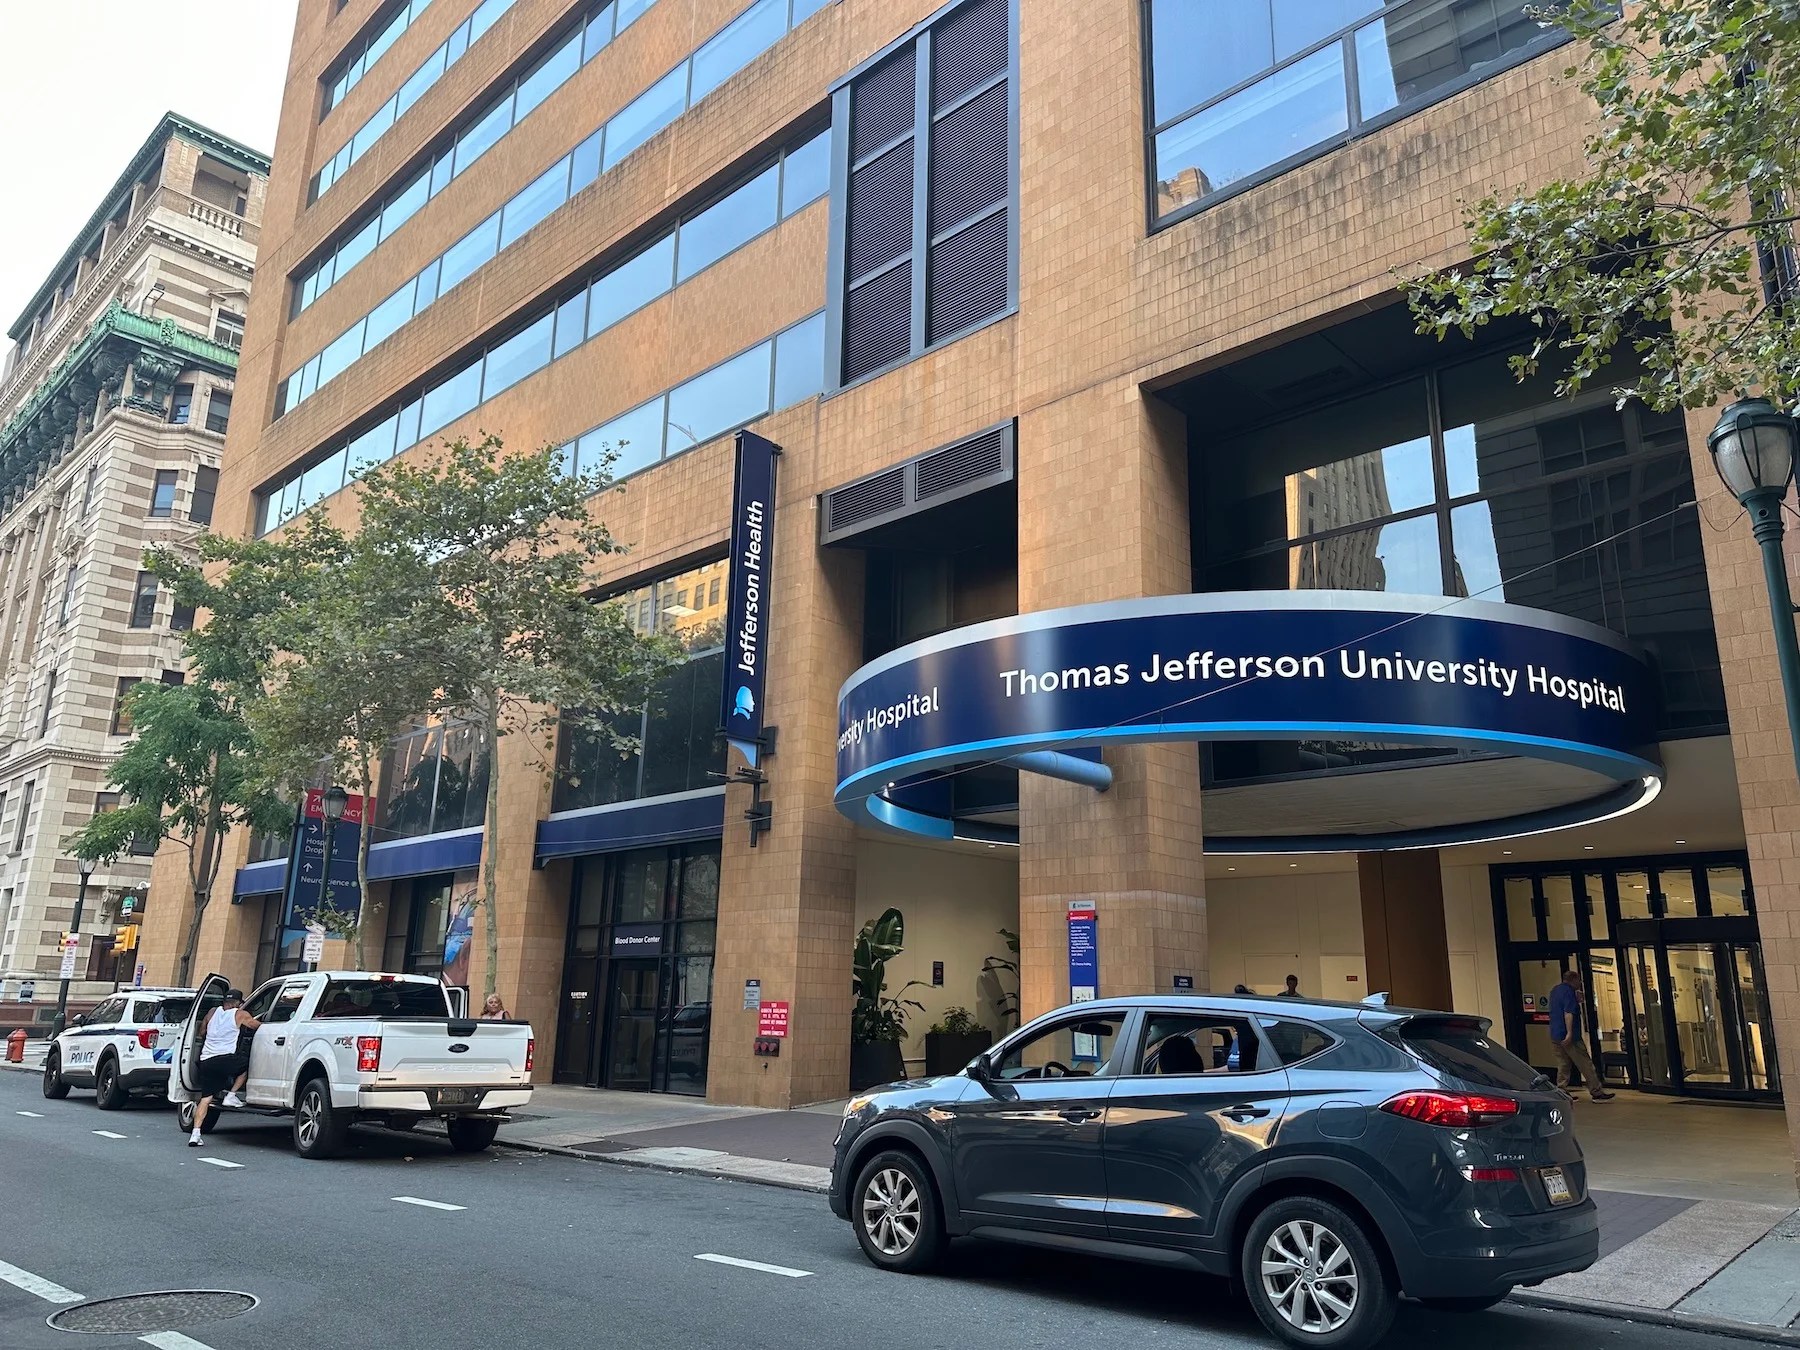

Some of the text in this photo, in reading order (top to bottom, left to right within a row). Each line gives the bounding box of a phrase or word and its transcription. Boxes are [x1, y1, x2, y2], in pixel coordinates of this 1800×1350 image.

[738, 500, 763, 676] Jefferson Health
[999, 649, 1626, 713] Thomas Jefferson University Hospital
[837, 686, 939, 755] versity Hospital
[614, 935, 661, 945] Blood Donor Center
[70, 1051, 95, 1064] POLICE
